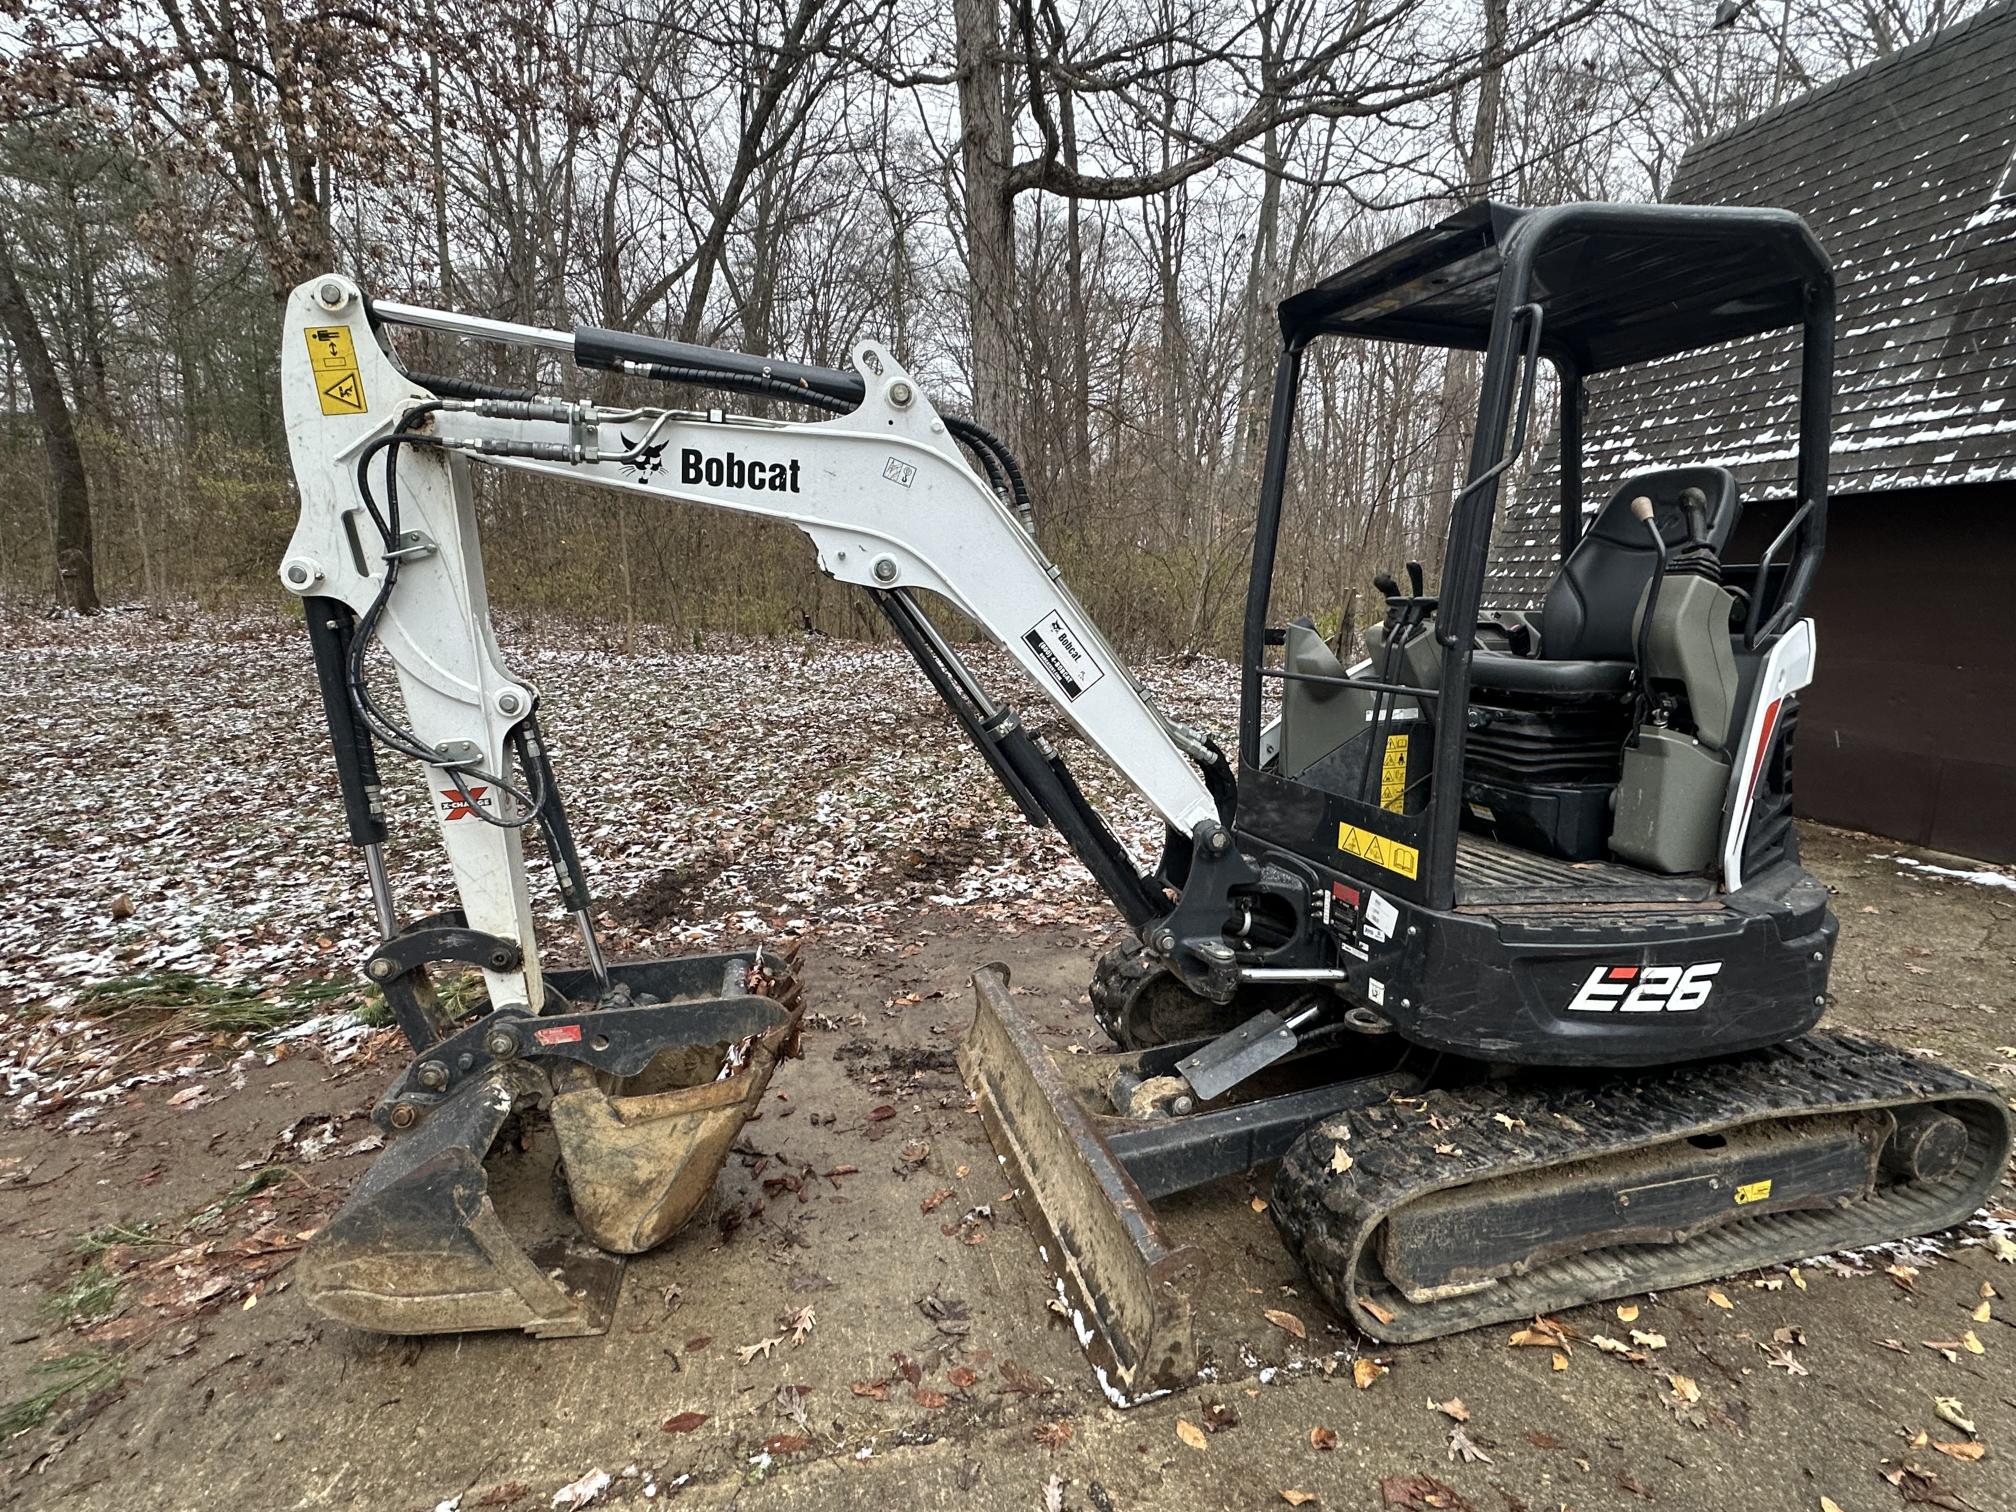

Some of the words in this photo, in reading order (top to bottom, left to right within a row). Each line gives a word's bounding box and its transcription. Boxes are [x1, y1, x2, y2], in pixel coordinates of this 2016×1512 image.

[681, 448, 800, 493] Bobcat
[1057, 632, 1082, 662] Bobcat
[442, 799, 490, 810] X-CHAGE
[1567, 961, 1724, 1012] E26
